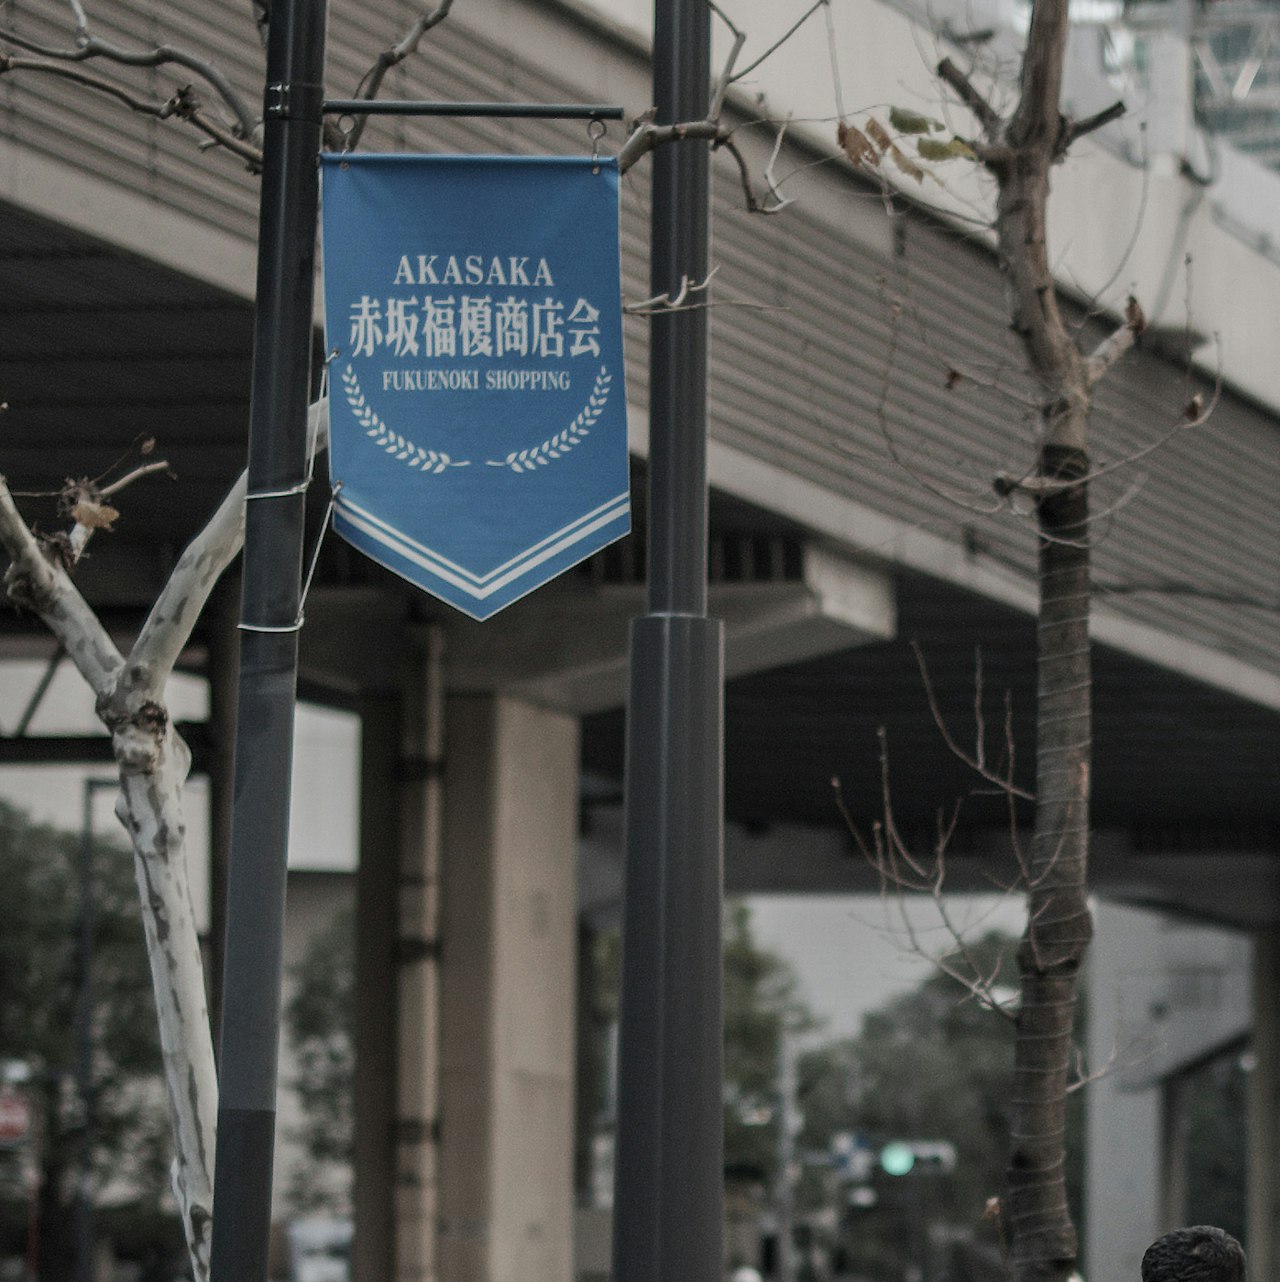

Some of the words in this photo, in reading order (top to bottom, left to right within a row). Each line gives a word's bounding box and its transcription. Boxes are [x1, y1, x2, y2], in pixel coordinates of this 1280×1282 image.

[393, 254, 554, 287] AKASAKA
[349, 295, 601, 358] 赤坂福榎商店会
[383, 369, 479, 391] FUKUENOKI
[485, 370, 571, 391] SHOPPING
